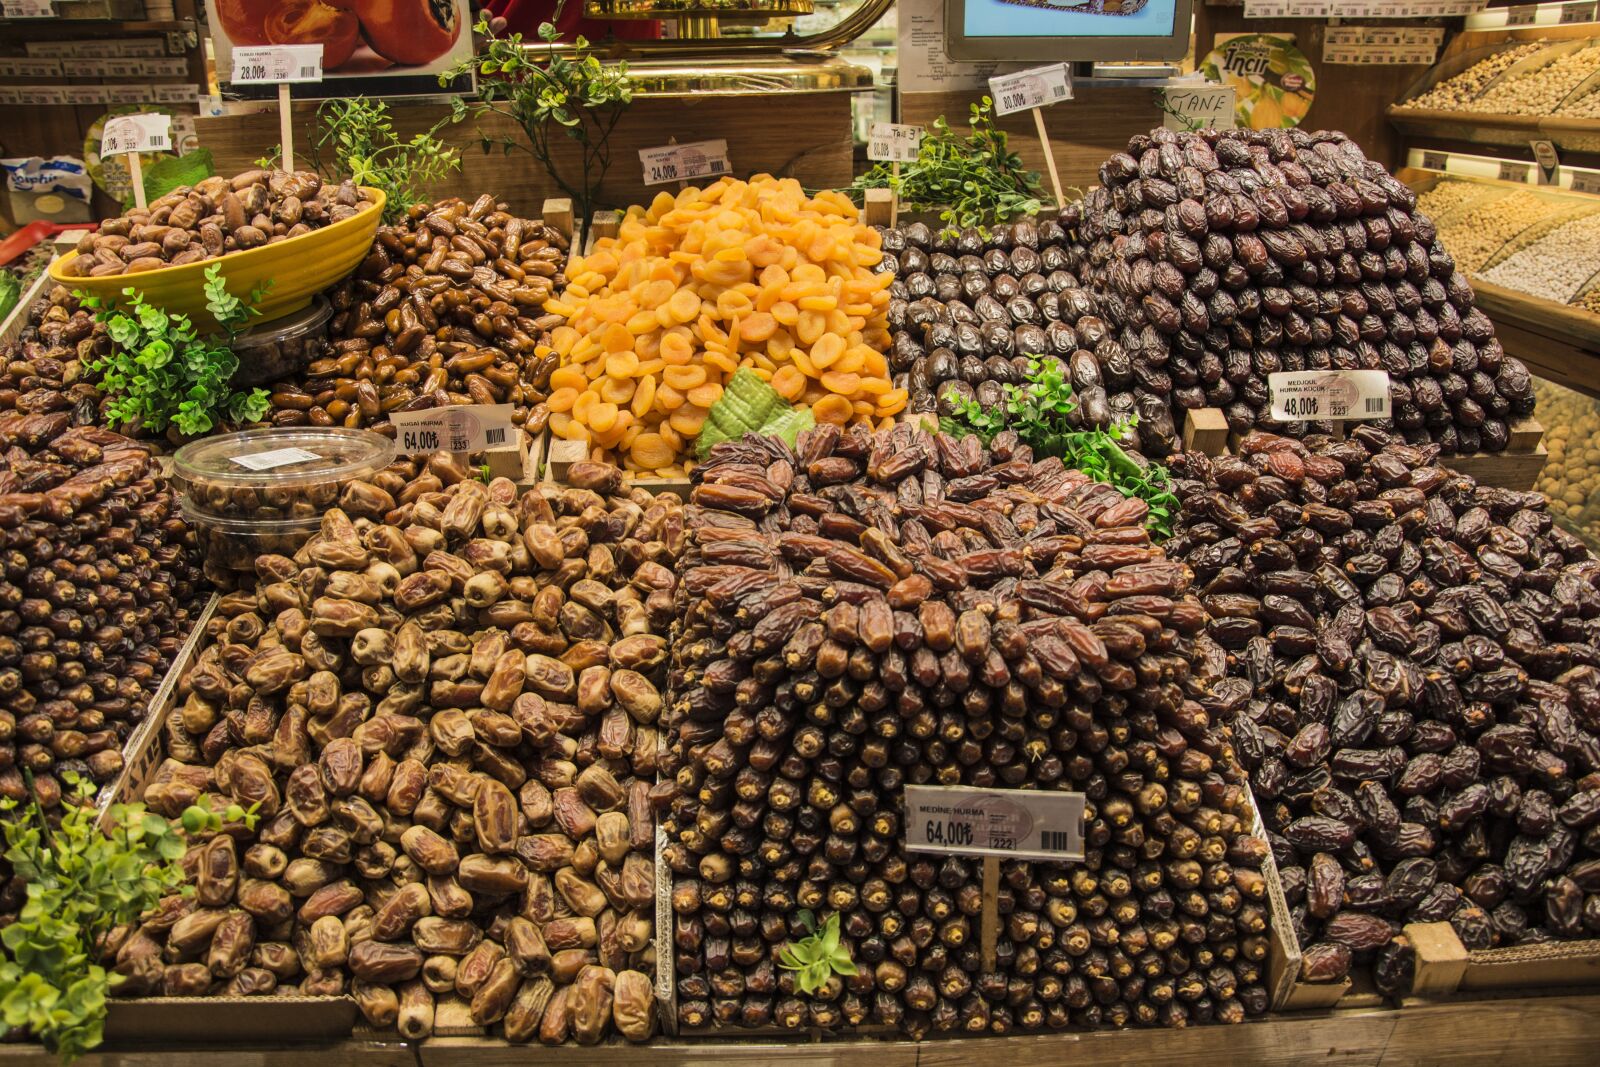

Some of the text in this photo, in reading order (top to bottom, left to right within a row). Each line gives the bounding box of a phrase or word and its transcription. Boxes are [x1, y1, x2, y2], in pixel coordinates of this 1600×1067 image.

[1171, 92, 1226, 112] TANE
[1284, 397, 1319, 419] 48,00₺
[1332, 406, 1346, 416] 223
[404, 431, 439, 453] 64,00₺
[453, 440, 467, 450] 233
[919, 804, 985, 817] MEDİNE HURMA
[926, 819, 974, 848] 64,00₺
[993, 839, 1012, 850] 222
